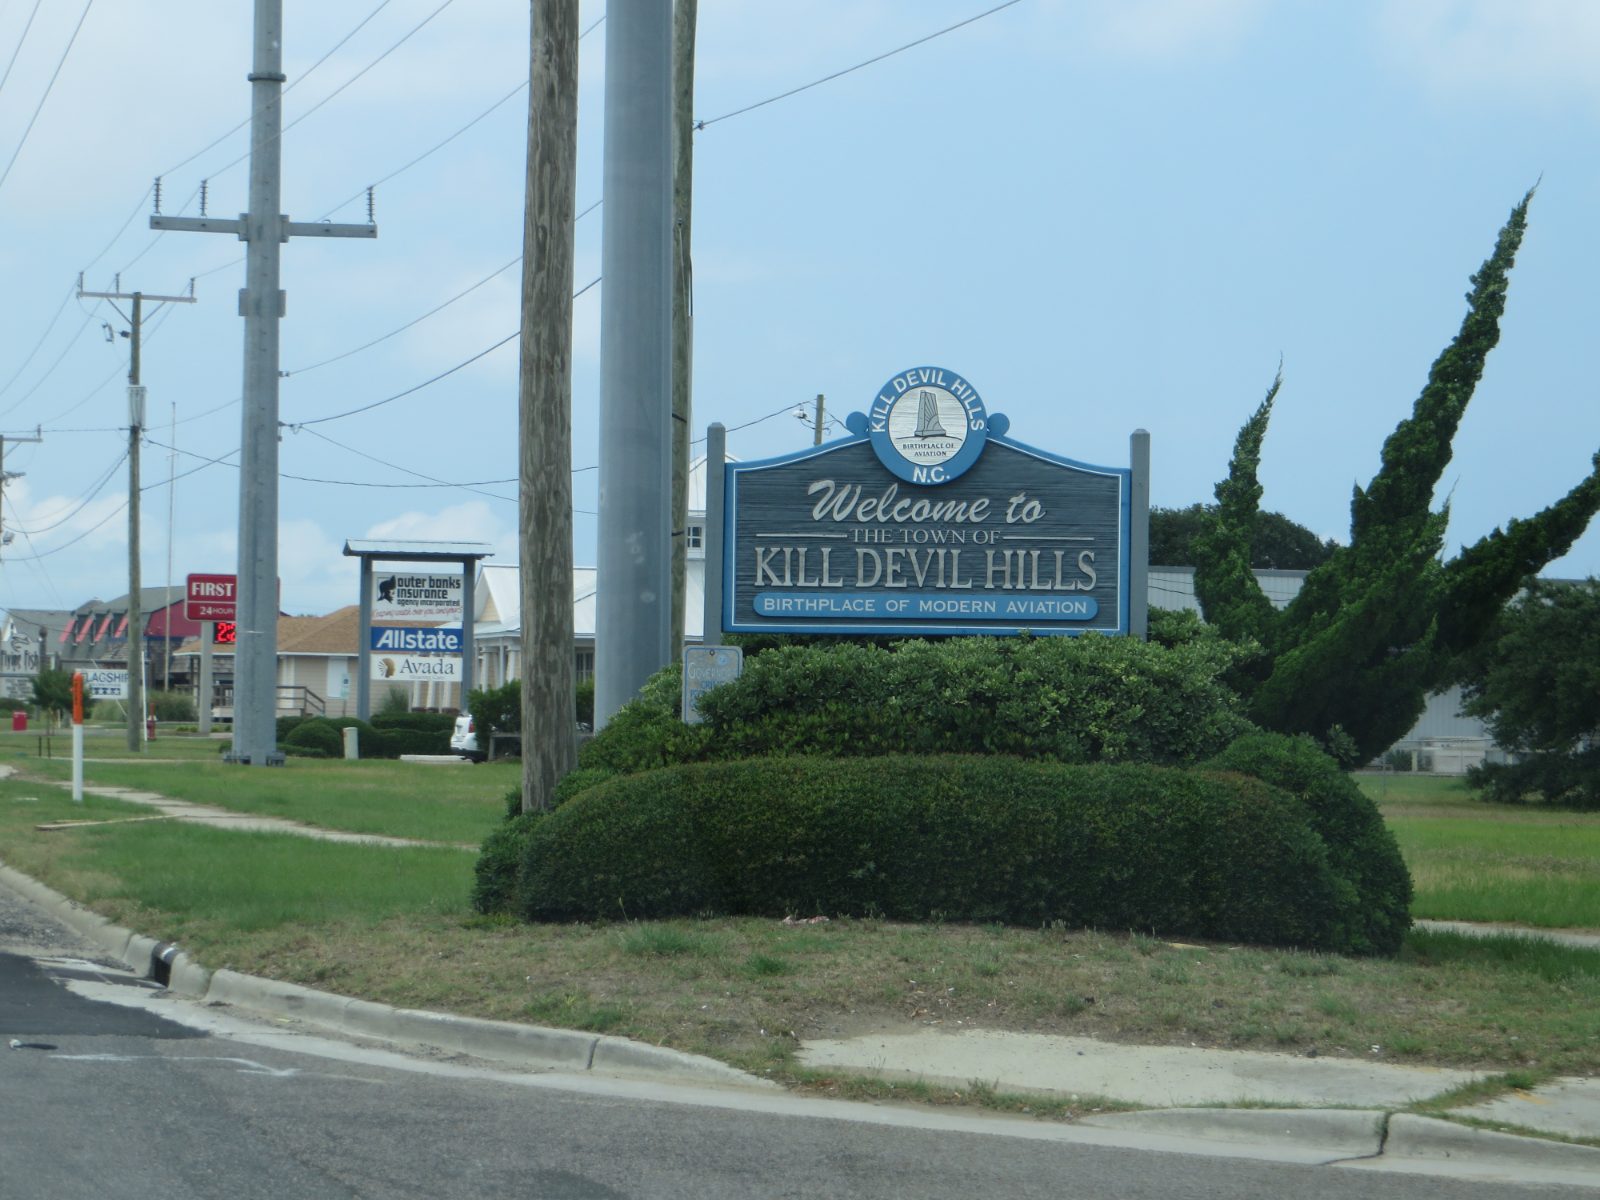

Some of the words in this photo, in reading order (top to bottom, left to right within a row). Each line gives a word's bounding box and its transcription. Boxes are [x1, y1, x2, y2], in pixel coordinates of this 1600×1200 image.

[872, 394, 895, 432] KILL
[893, 369, 946, 393] DEVIL
[951, 379, 984, 431] HILLS
[913, 466, 950, 483] N.C.
[808, 480, 992, 523] Welcome
[1006, 492, 1048, 524] to
[851, 529, 893, 543] THE
[899, 529, 966, 544] TOWN
[973, 530, 1001, 545] OF
[754, 547, 843, 587] KILL
[855, 548, 972, 589] DEVIL
[984, 550, 1097, 591] HILLS
[191, 582, 234, 597] FIRST
[397, 577, 427, 588] outer
[429, 575, 461, 589] banks
[397, 588, 448, 599] insurance
[763, 598, 876, 612] BIRTHPLACE
[885, 599, 910, 612] OF
[919, 600, 996, 613] MODERN
[1006, 601, 1087, 614] AVIATION
[376, 629, 458, 650] Allstate
[400, 658, 455, 675] Avada
